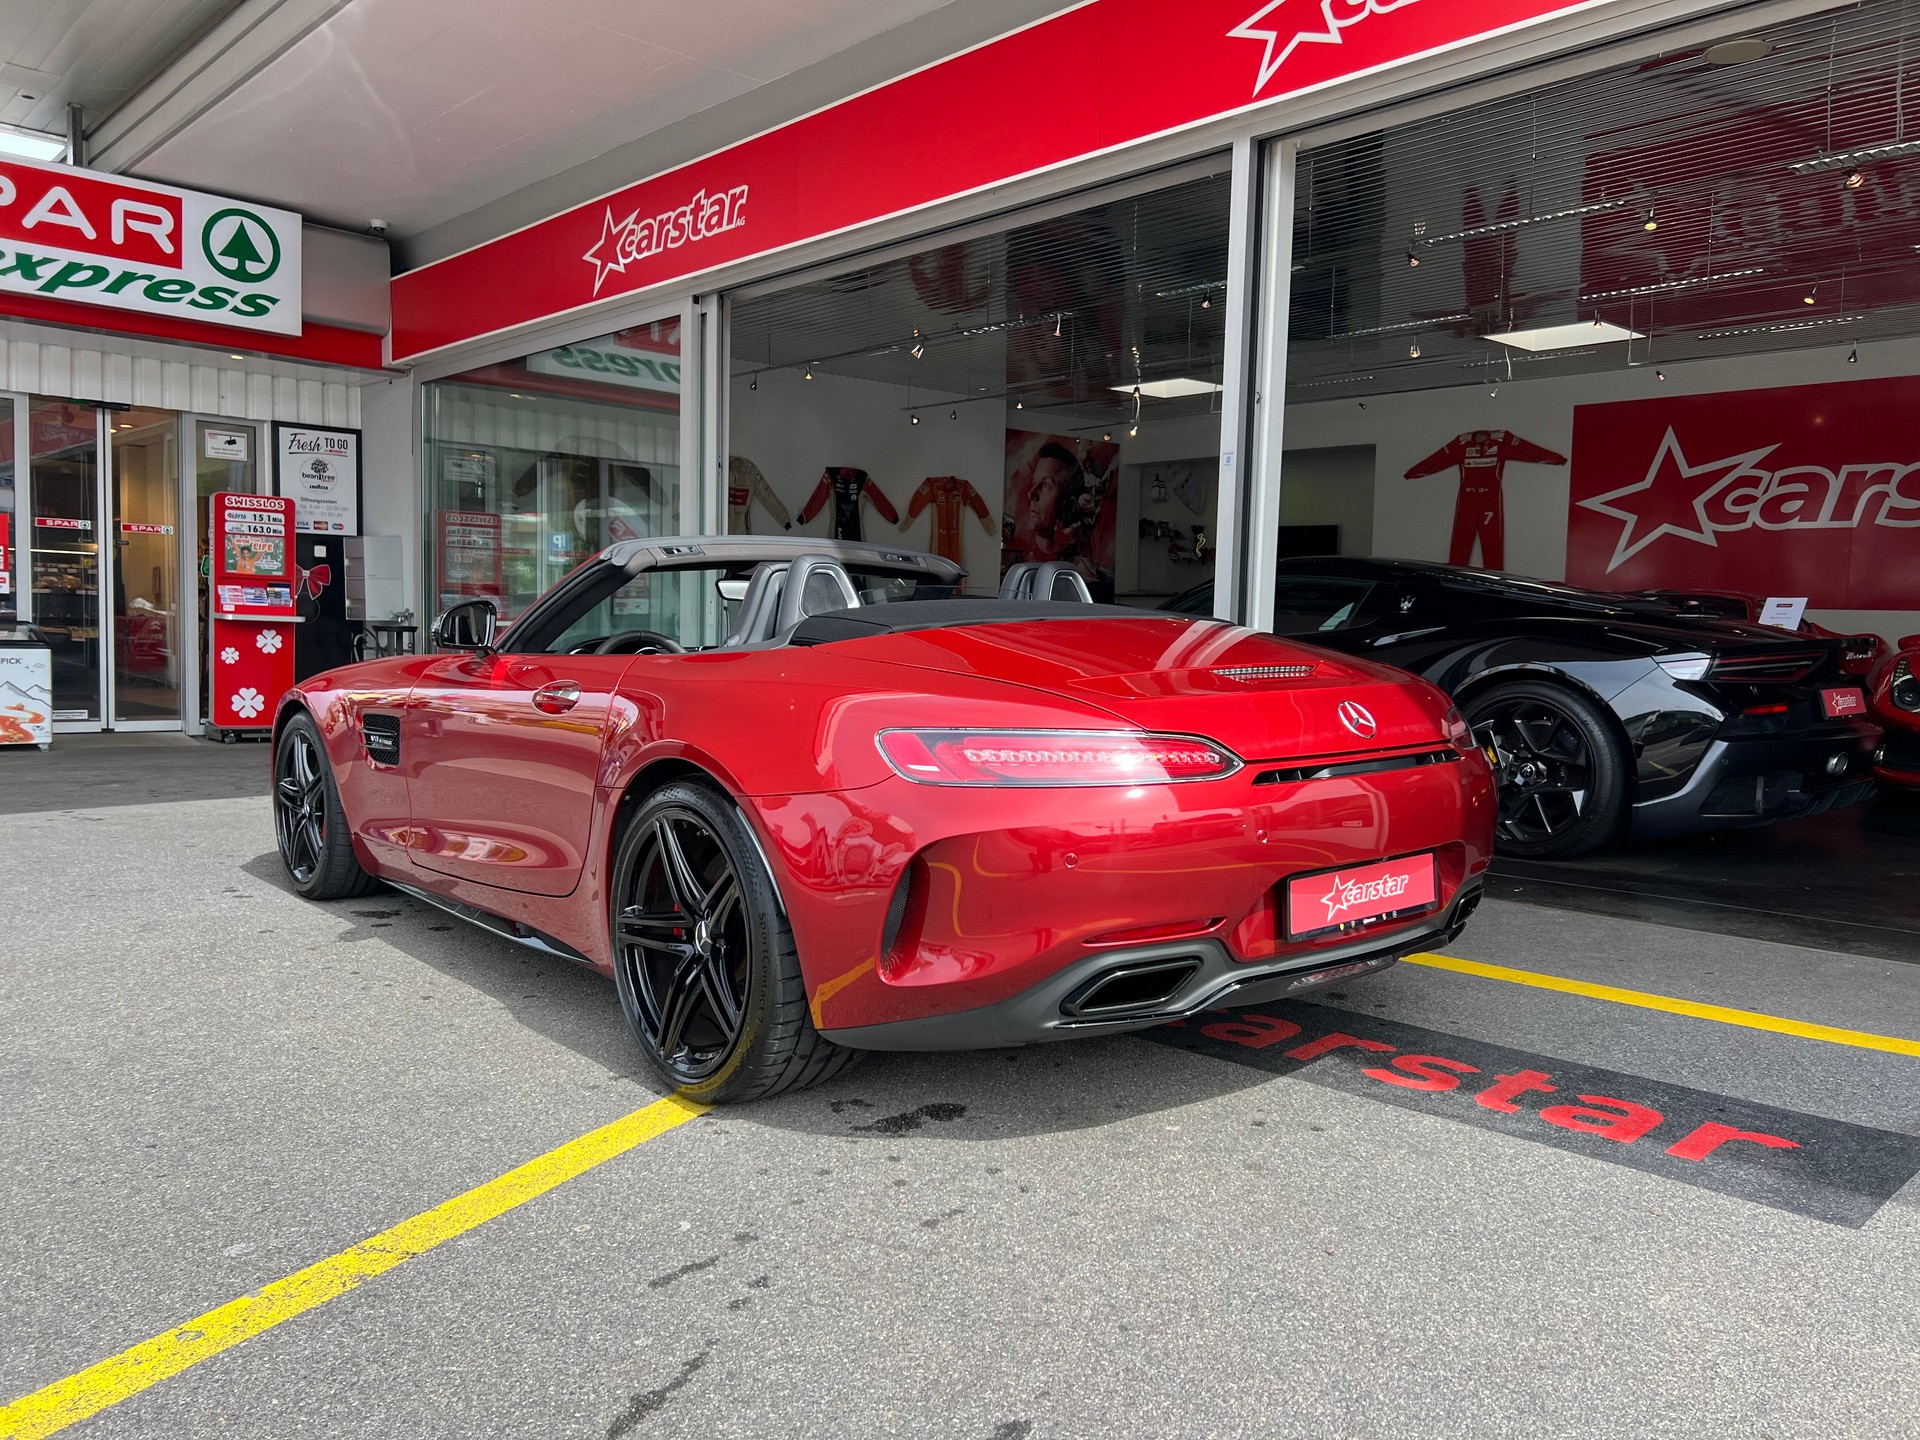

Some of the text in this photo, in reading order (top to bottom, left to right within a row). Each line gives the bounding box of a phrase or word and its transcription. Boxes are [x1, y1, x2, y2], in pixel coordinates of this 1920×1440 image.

[618, 184, 749, 265] carstar
[0, 250, 281, 317] xpress
[288, 433, 322, 452] Fresh
[324, 437, 335, 449] TO
[337, 439, 348, 450] GO
[226, 497, 284, 510] SWISSLOS
[45, 519, 79, 528] SPAR
[1484, 511, 1494, 525] 7
[253, 543, 273, 552] LIFE
[1345, 873, 1408, 906] carstar
[1163, 1007, 1802, 1162] arstar
